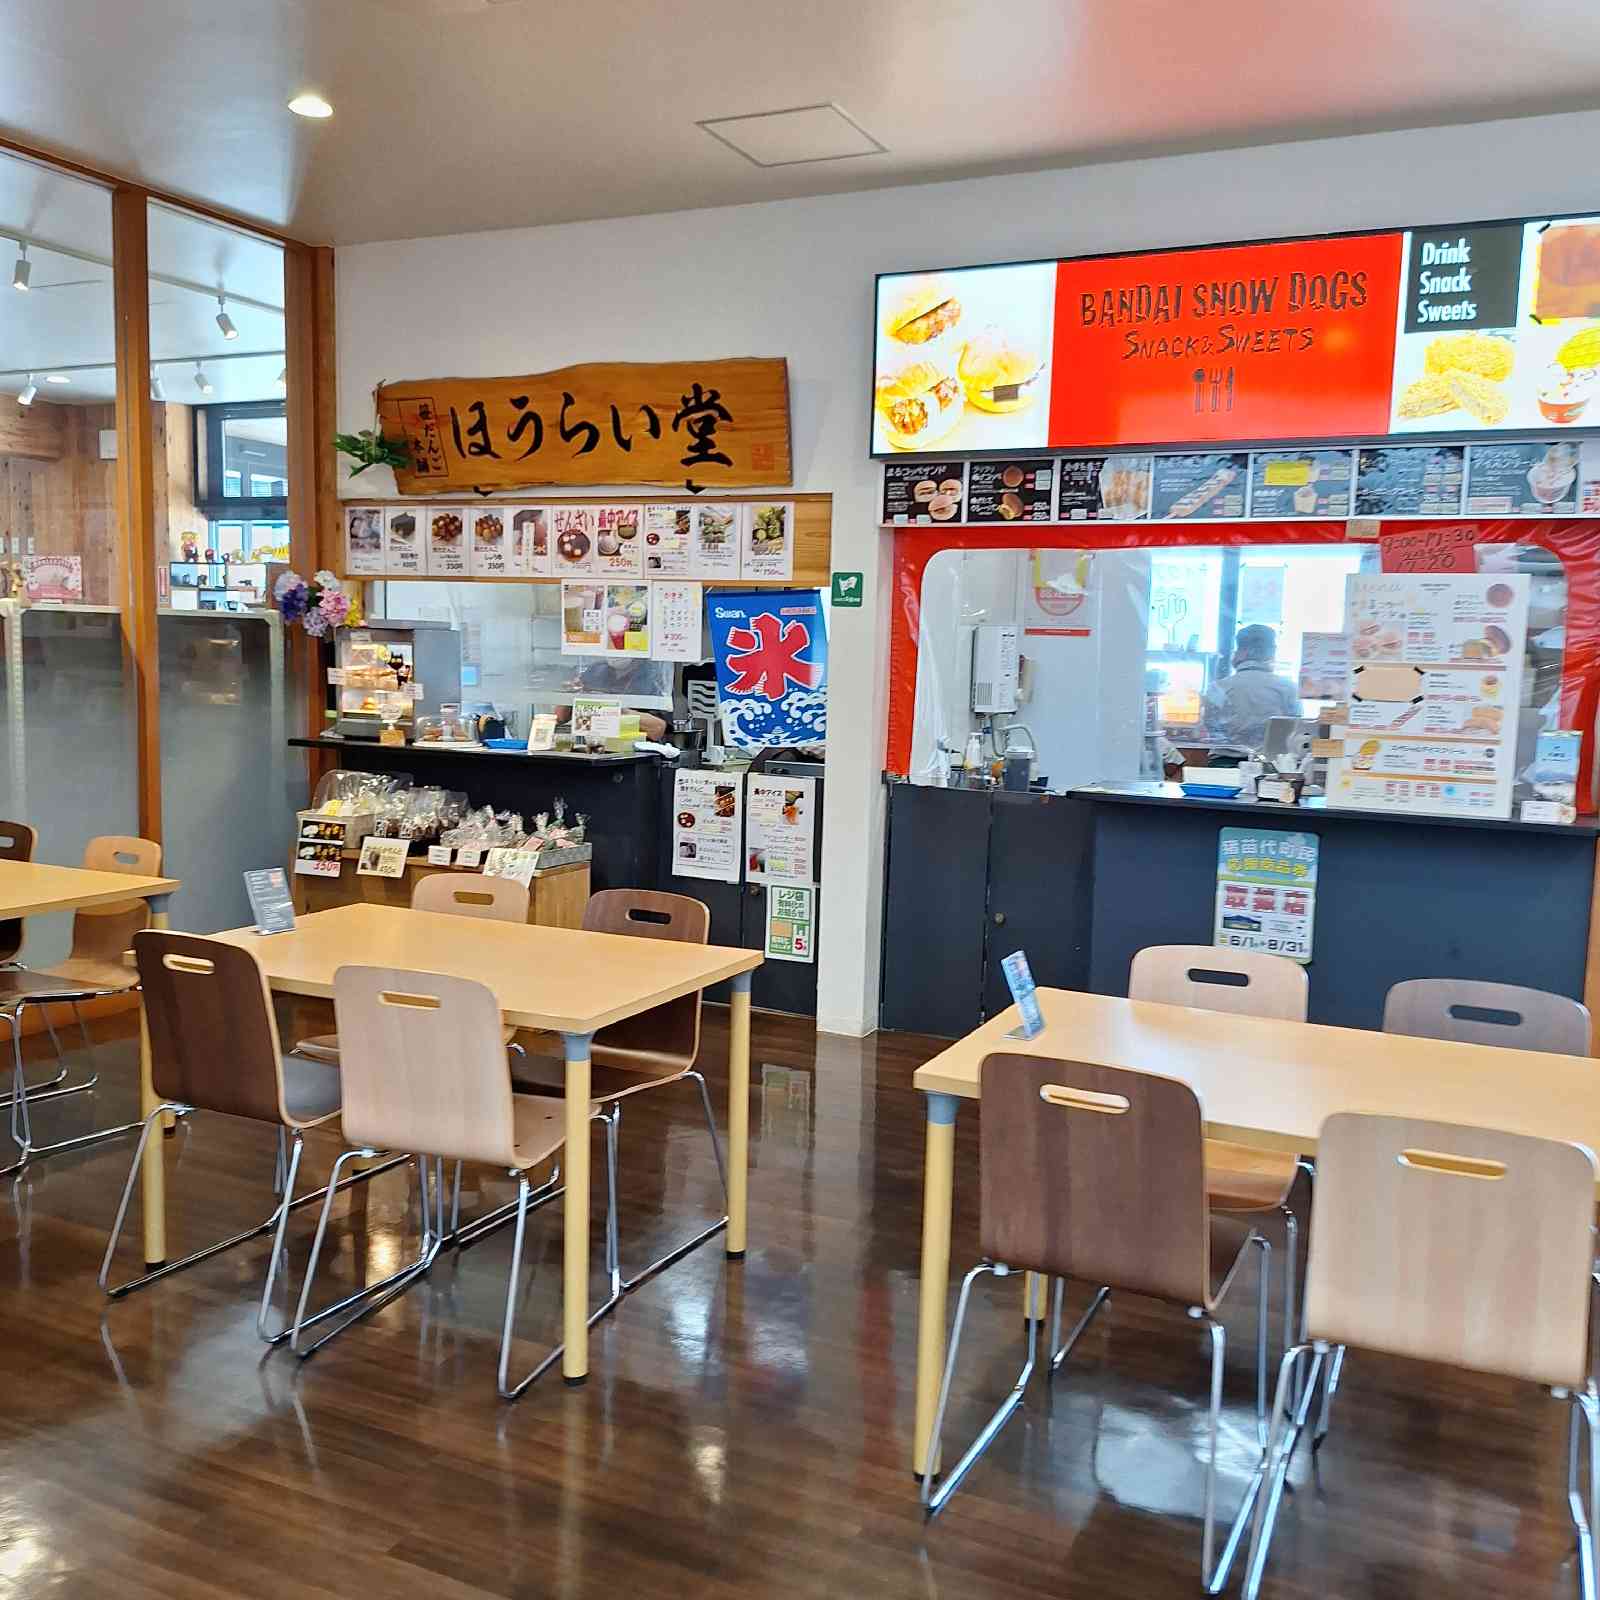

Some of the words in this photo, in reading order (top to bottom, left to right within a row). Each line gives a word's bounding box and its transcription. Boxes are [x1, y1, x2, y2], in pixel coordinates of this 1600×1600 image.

[1421, 238, 1471, 266] Drink
[1080, 285, 1184, 328] BANDAI
[1192, 275, 1280, 318] SNOW
[1288, 270, 1369, 313] DOGS
[1419, 267, 1472, 295] Snack
[1417, 300, 1477, 323] Sweets
[450, 383, 735, 468] ほうらい堂
[725, 612, 825, 701] 氷
